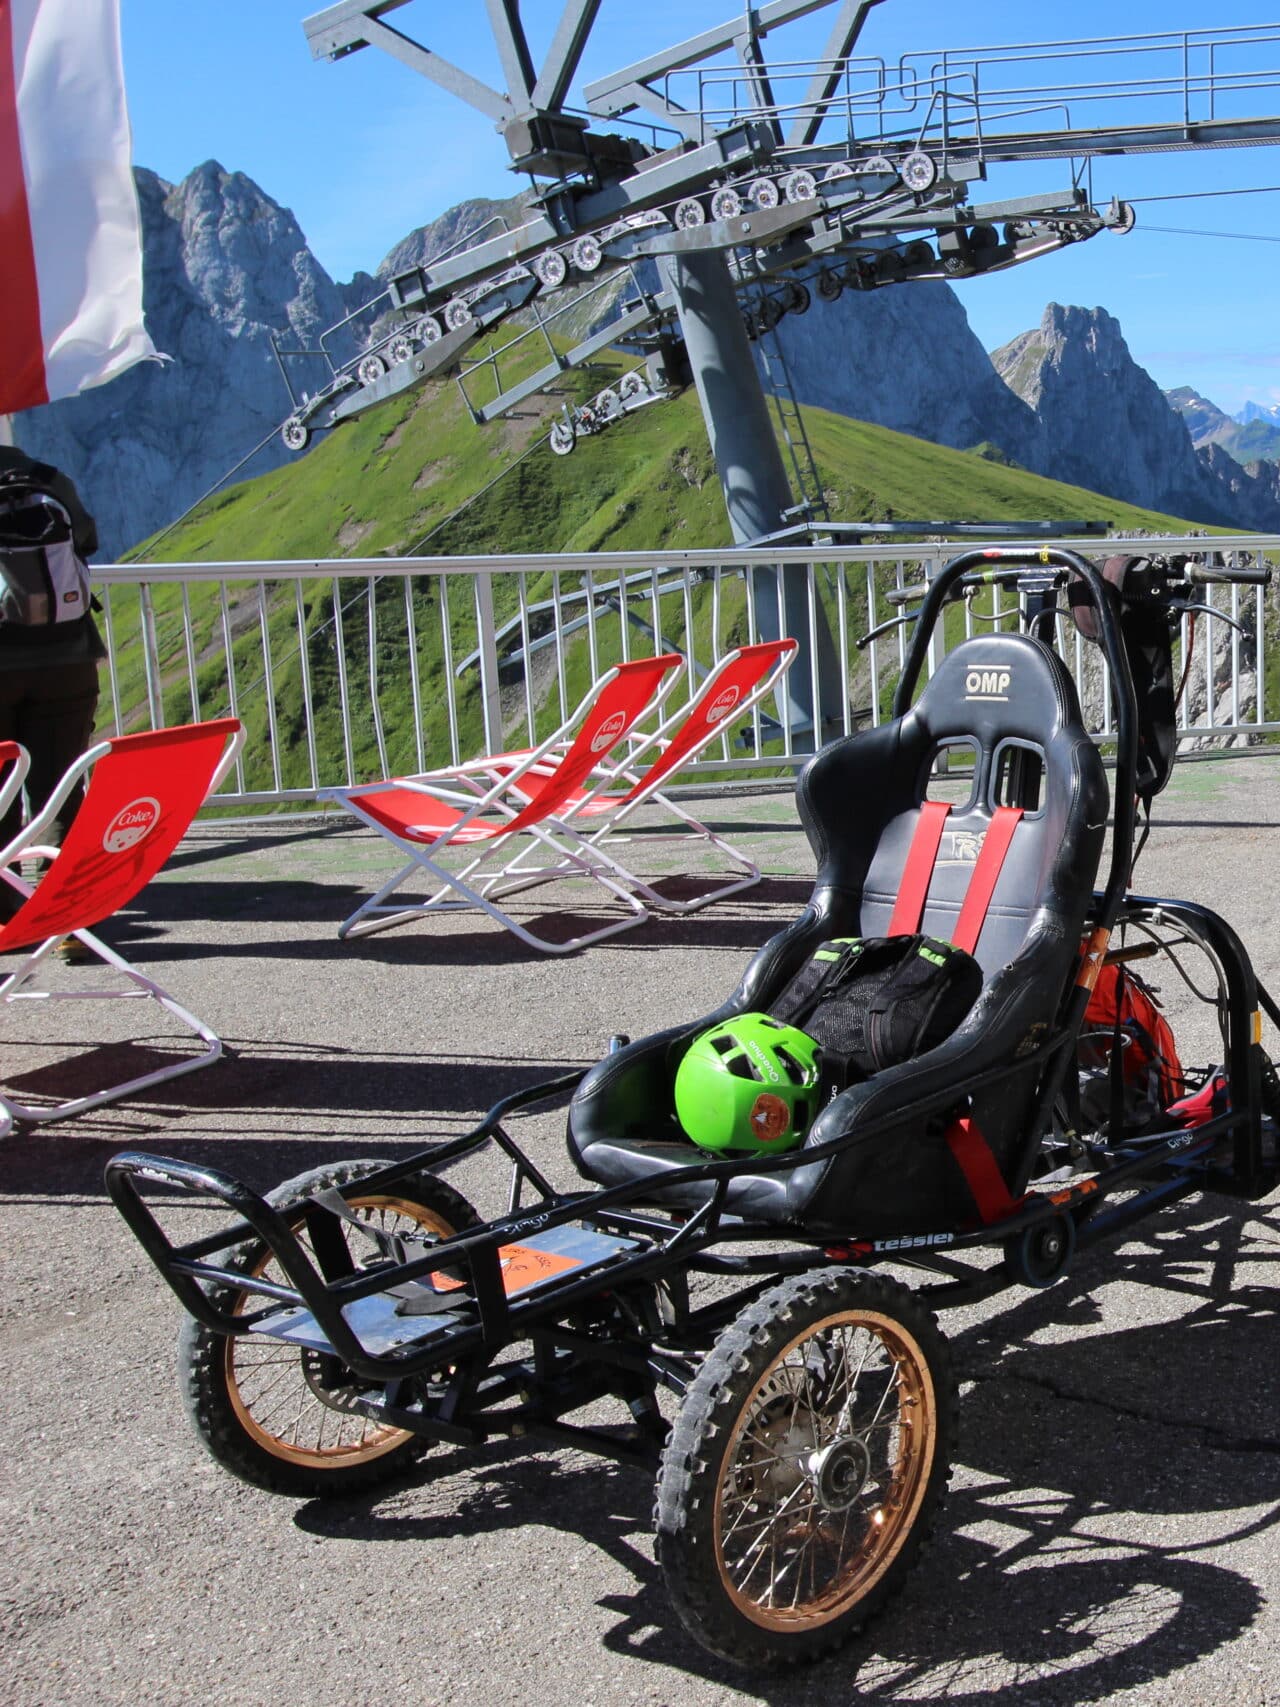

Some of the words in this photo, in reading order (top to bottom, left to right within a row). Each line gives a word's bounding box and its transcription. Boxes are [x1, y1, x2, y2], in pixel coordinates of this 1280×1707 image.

[965, 672, 1011, 693] OMP
[119, 810, 152, 826] Coke
[749, 1040, 779, 1082] Quechua
